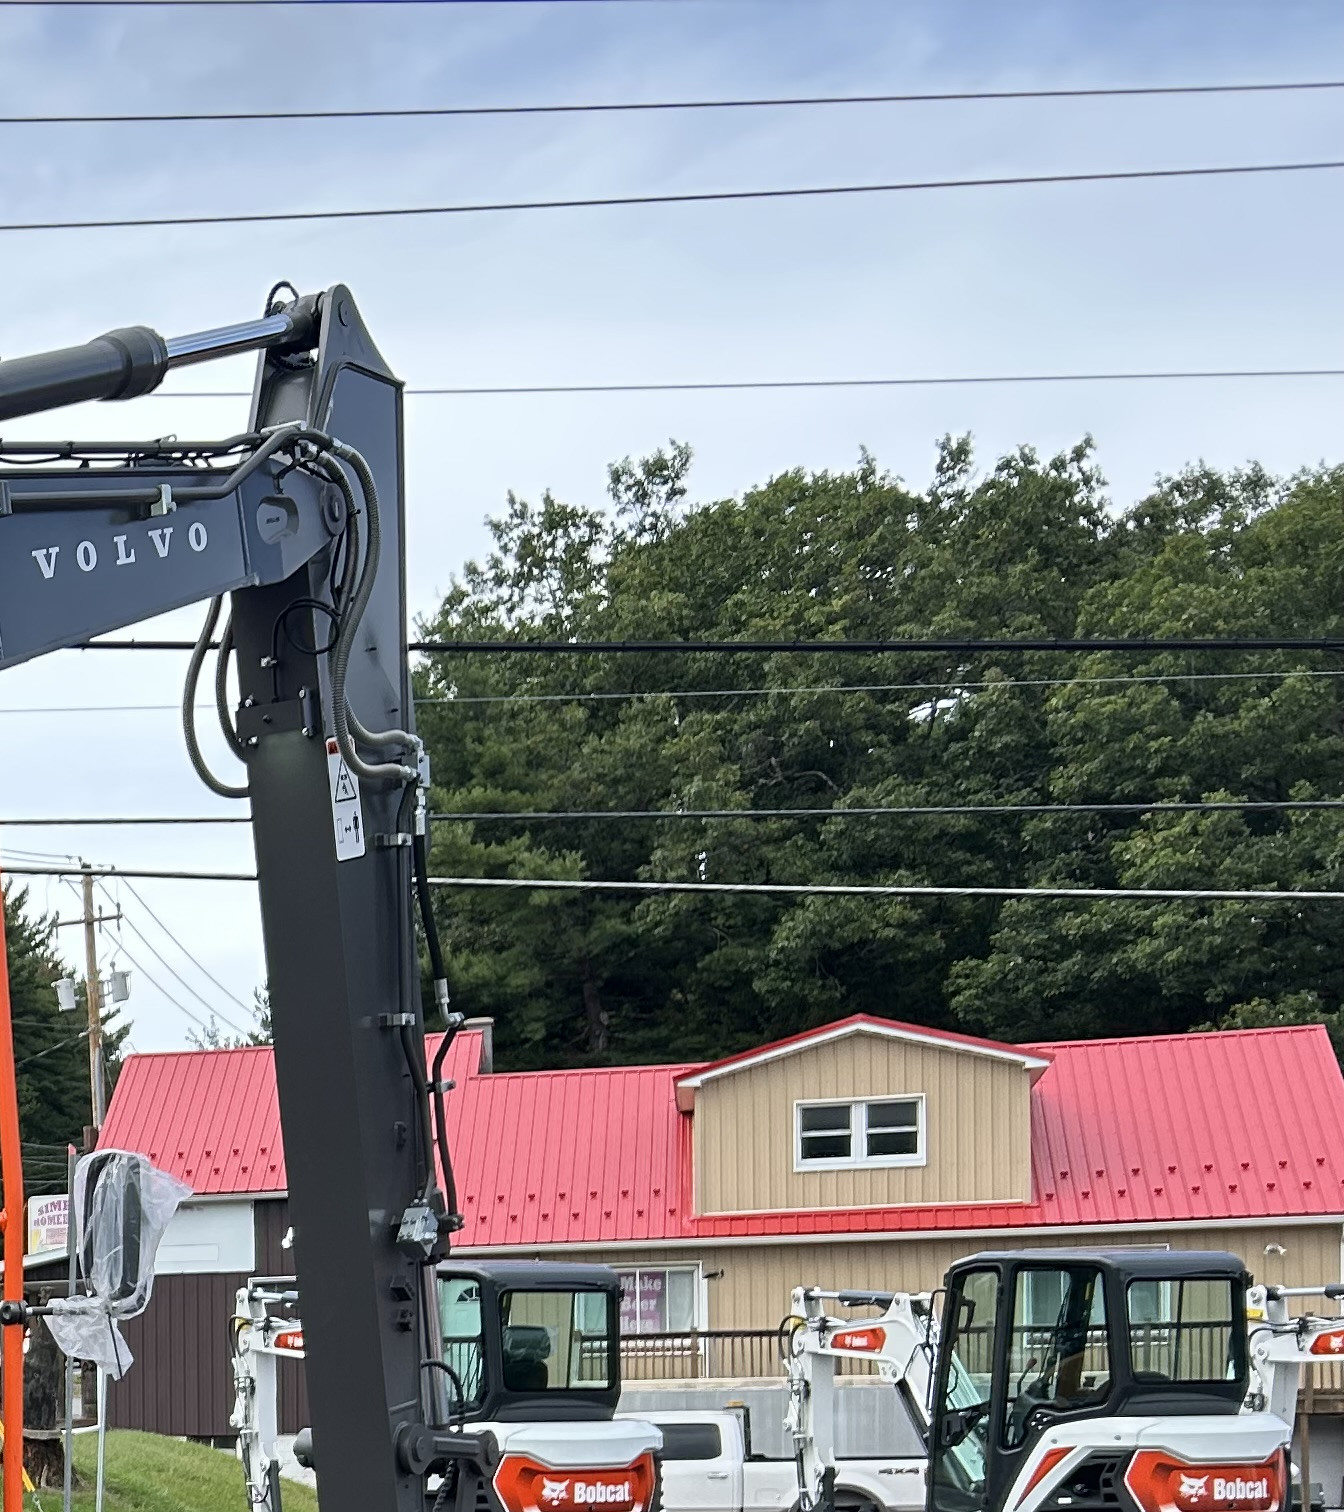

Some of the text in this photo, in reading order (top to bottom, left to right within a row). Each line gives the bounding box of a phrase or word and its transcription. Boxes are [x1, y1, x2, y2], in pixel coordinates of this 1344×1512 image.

[31, 522, 208, 579] VOLVO
[573, 1481, 630, 1504] Bobcat
[1213, 1477, 1268, 1501] Bobcat
